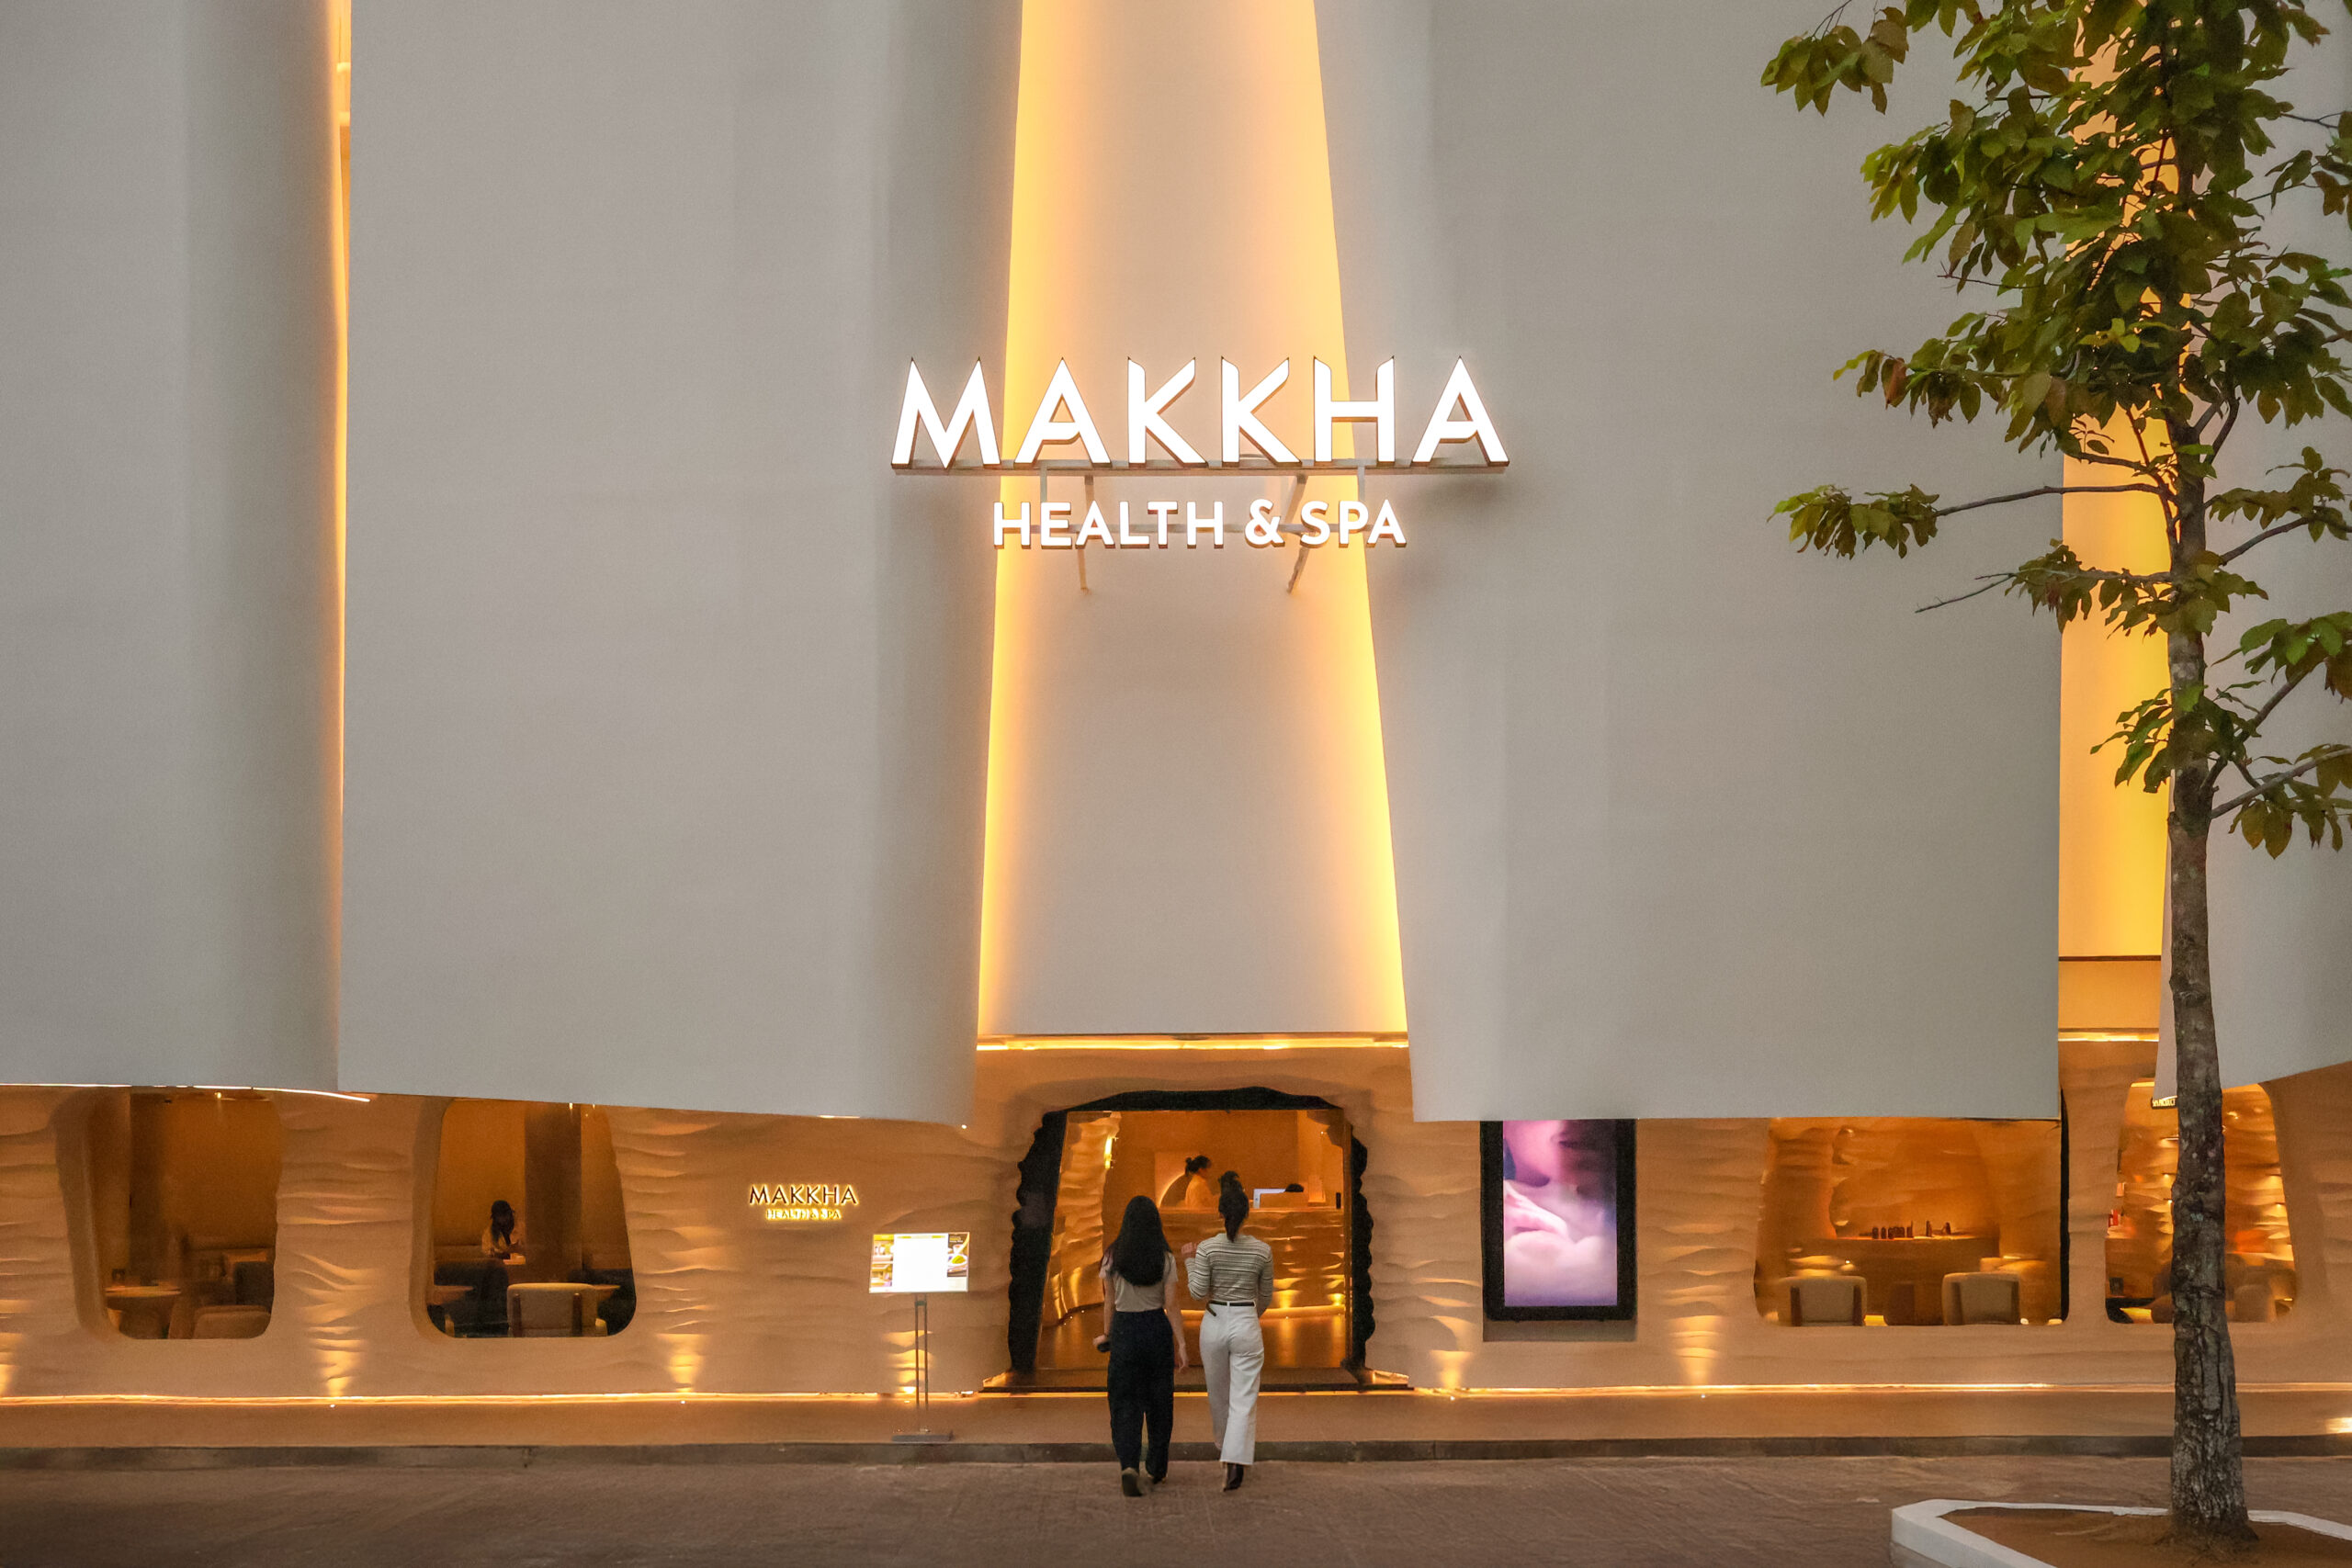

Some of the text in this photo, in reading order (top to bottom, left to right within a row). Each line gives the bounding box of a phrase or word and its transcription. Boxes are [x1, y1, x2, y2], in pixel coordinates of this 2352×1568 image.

[891, 356, 1510, 468] MAKKHA
[993, 498, 1408, 549] HEALTH & SPA
[749, 1184, 858, 1205] MAKKHA
[766, 1208, 808, 1220] HEALTH
[820, 1208, 842, 1220] SPA
